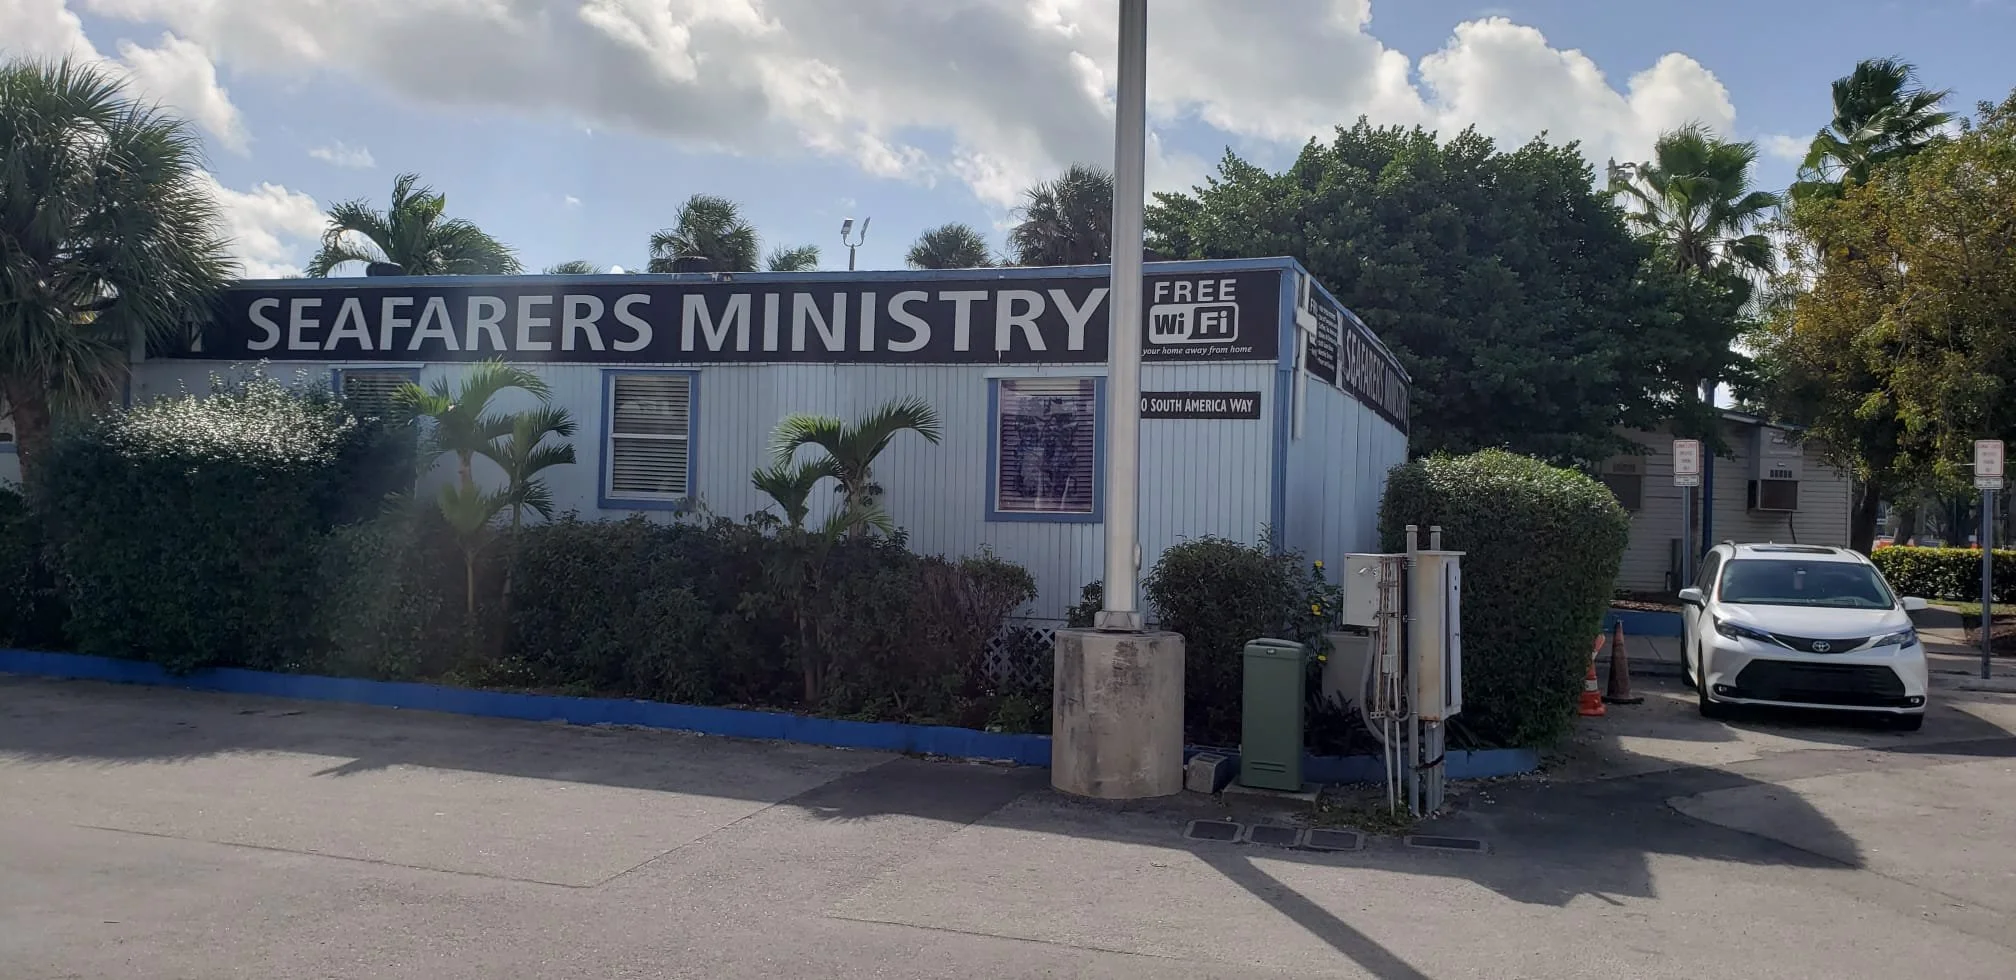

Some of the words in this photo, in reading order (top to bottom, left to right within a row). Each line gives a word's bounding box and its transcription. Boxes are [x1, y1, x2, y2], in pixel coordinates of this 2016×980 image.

[1154, 279, 1237, 303] FREE
[247, 294, 653, 352] SEAFARERS
[681, 288, 1109, 352] MINISTRY
[1141, 348, 1160, 356] your
[1162, 347, 1183, 355] home
[1185, 347, 1208, 356] away
[1207, 346, 1228, 355] from
[1230, 345, 1253, 353] home
[1151, 398, 1182, 412] SOUTH
[1185, 398, 1227, 412] AMERICA
[1230, 398, 1253, 412] WAY
